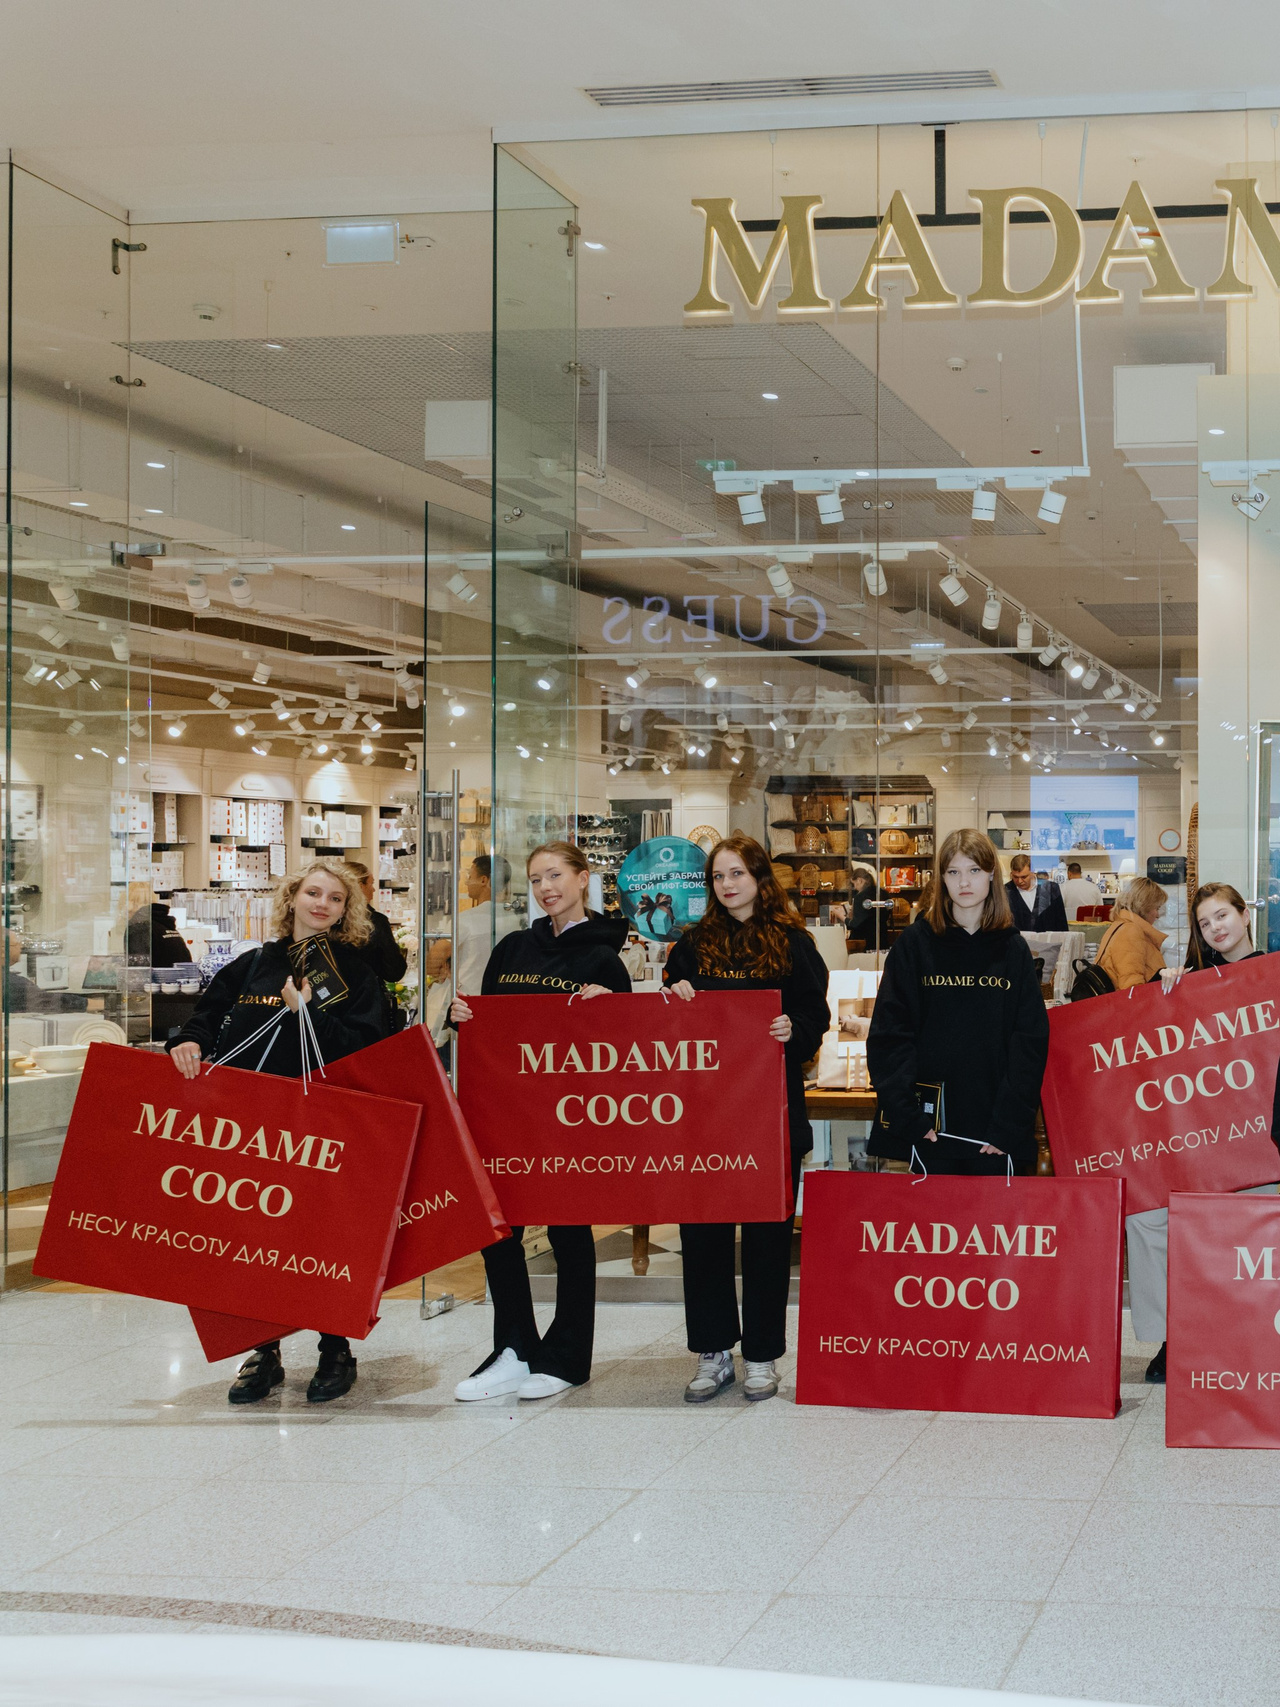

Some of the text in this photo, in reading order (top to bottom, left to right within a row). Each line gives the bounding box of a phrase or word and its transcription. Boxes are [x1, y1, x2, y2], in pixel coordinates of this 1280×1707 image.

[626, 871, 667, 882] УСПЕЙТЕ
[628, 882, 655, 891] СВОЙ
[1089, 1000, 1280, 1073] MADAME
[518, 1040, 720, 1074] MADAME
[1135, 1058, 1255, 1112] COCO
[556, 1093, 684, 1126] COCO
[133, 1103, 345, 1173] MADAME
[1074, 1115, 1267, 1175] НЕСУ КРАСОТУ ДЛЯ
[542, 1156, 636, 1174] КРАСОТУ
[643, 1155, 684, 1174] ДЛЯ
[691, 1154, 759, 1173] ДОМА
[161, 1165, 293, 1218] COCO
[398, 1190, 458, 1229] ДОМА
[68, 1211, 352, 1282] НЕСУ КРАСОТУ ДЛЯ ДОМА
[859, 1221, 1058, 1257] MADAME
[894, 1276, 1020, 1310] COCO
[820, 1336, 1091, 1363] НЕСУ КРАСОТУ ДЛЯ ДОМА
[1191, 1371, 1250, 1391] НЕСУ
